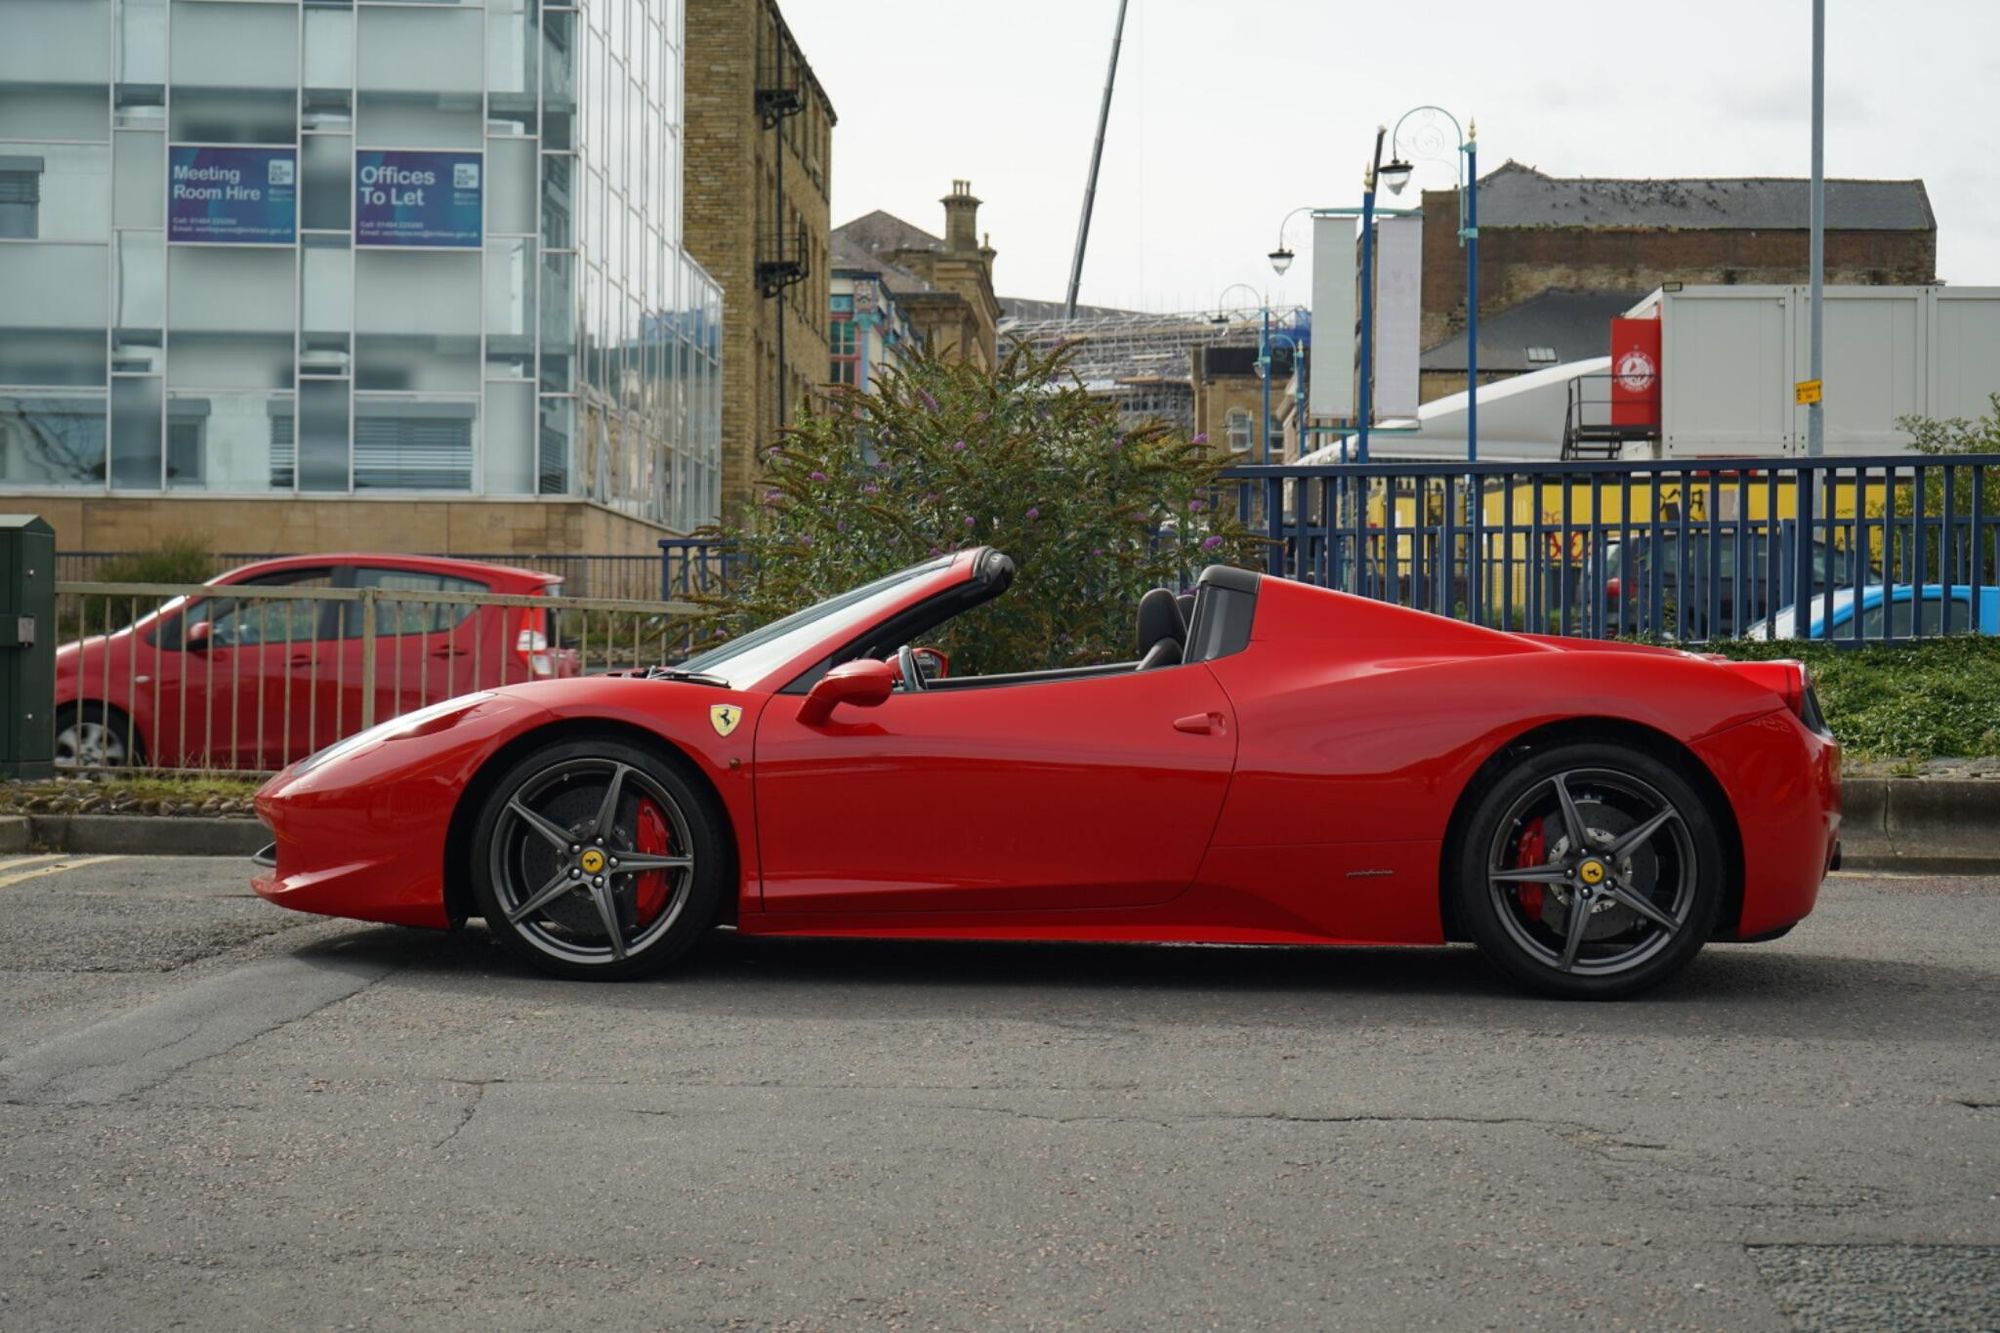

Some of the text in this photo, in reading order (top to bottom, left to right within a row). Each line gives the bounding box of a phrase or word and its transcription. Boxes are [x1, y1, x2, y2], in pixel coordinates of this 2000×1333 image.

[174, 165, 241, 185] Meeting
[360, 165, 436, 186] Offices
[174, 184, 222, 200] Room
[225, 185, 261, 200] Hire
[360, 186, 425, 206] To Let
